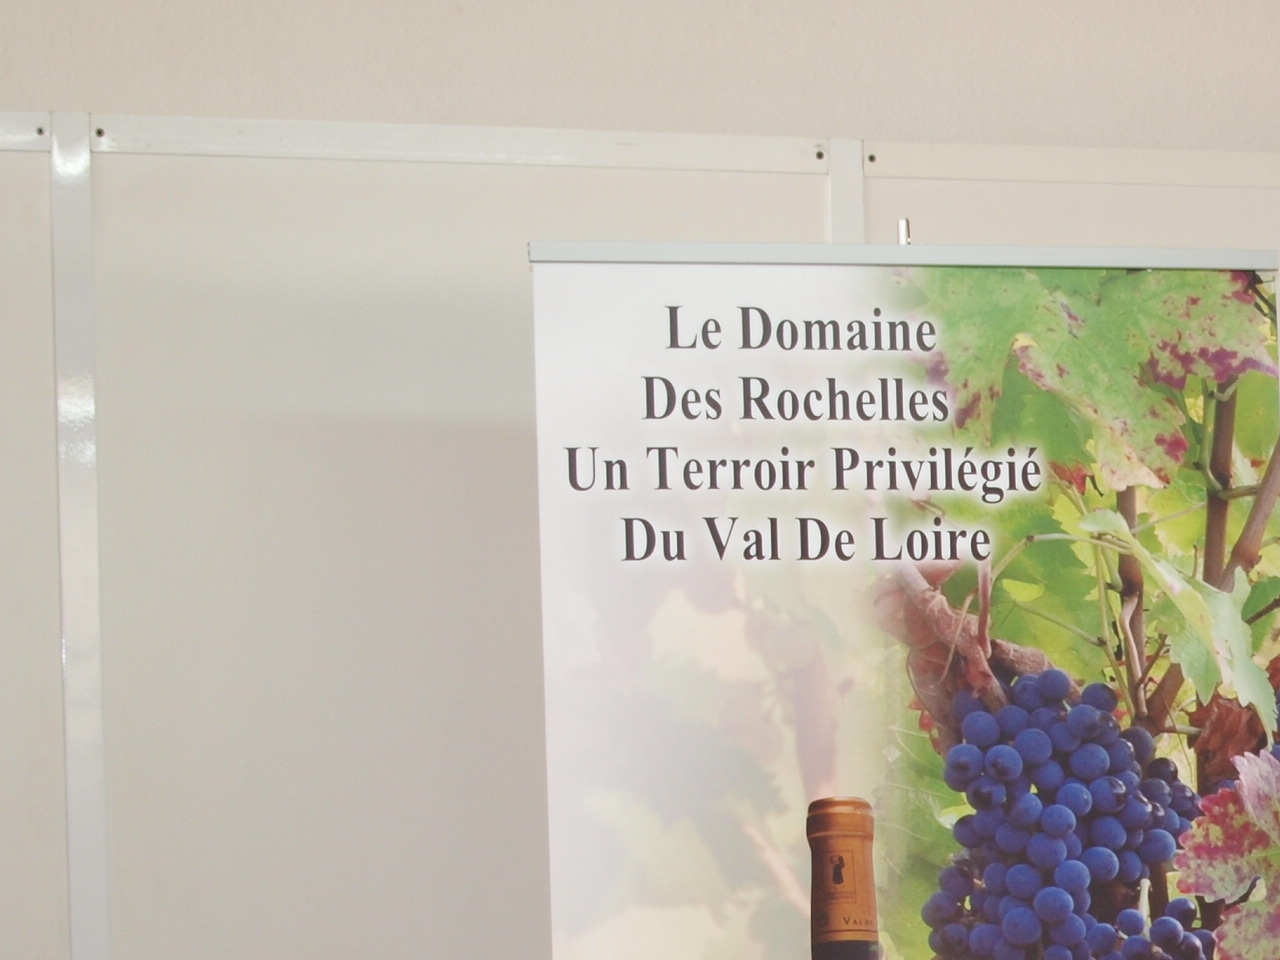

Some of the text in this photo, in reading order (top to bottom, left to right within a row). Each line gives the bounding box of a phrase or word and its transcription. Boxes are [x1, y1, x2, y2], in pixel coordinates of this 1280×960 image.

[664, 304, 937, 352] Le Domaine
[641, 375, 950, 423] Des Rochelles
[563, 446, 1042, 505] Un Terroir Privilégié
[620, 515, 992, 562] Du Val De Loire
